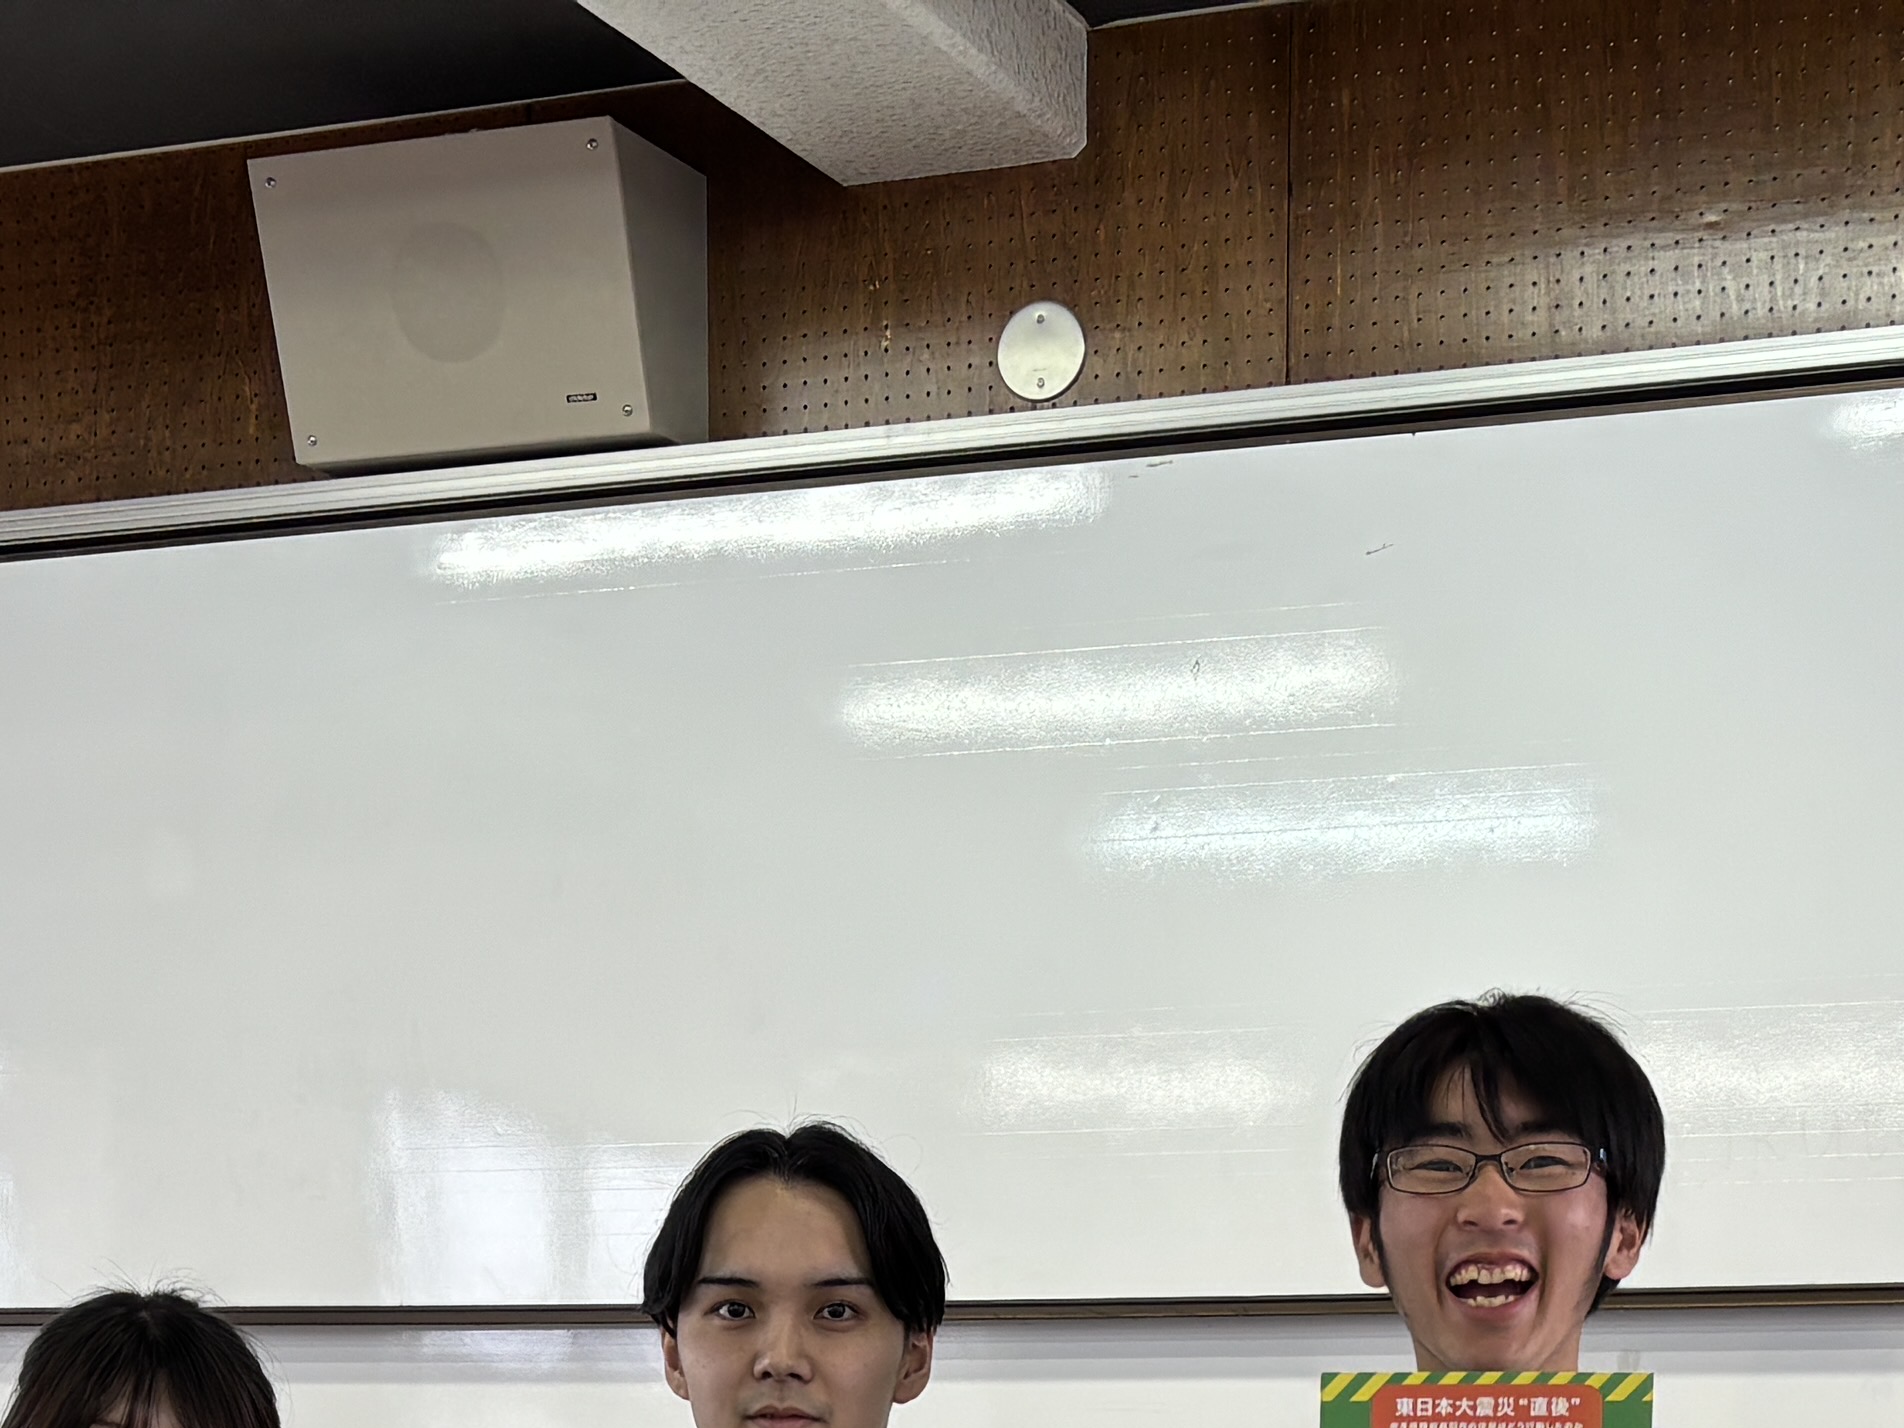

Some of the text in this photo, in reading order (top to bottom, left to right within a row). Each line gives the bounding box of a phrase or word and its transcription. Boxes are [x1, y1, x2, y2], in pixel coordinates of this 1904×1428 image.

[1395, 1396, 1581, 1417] 東日本大震災“直後”
